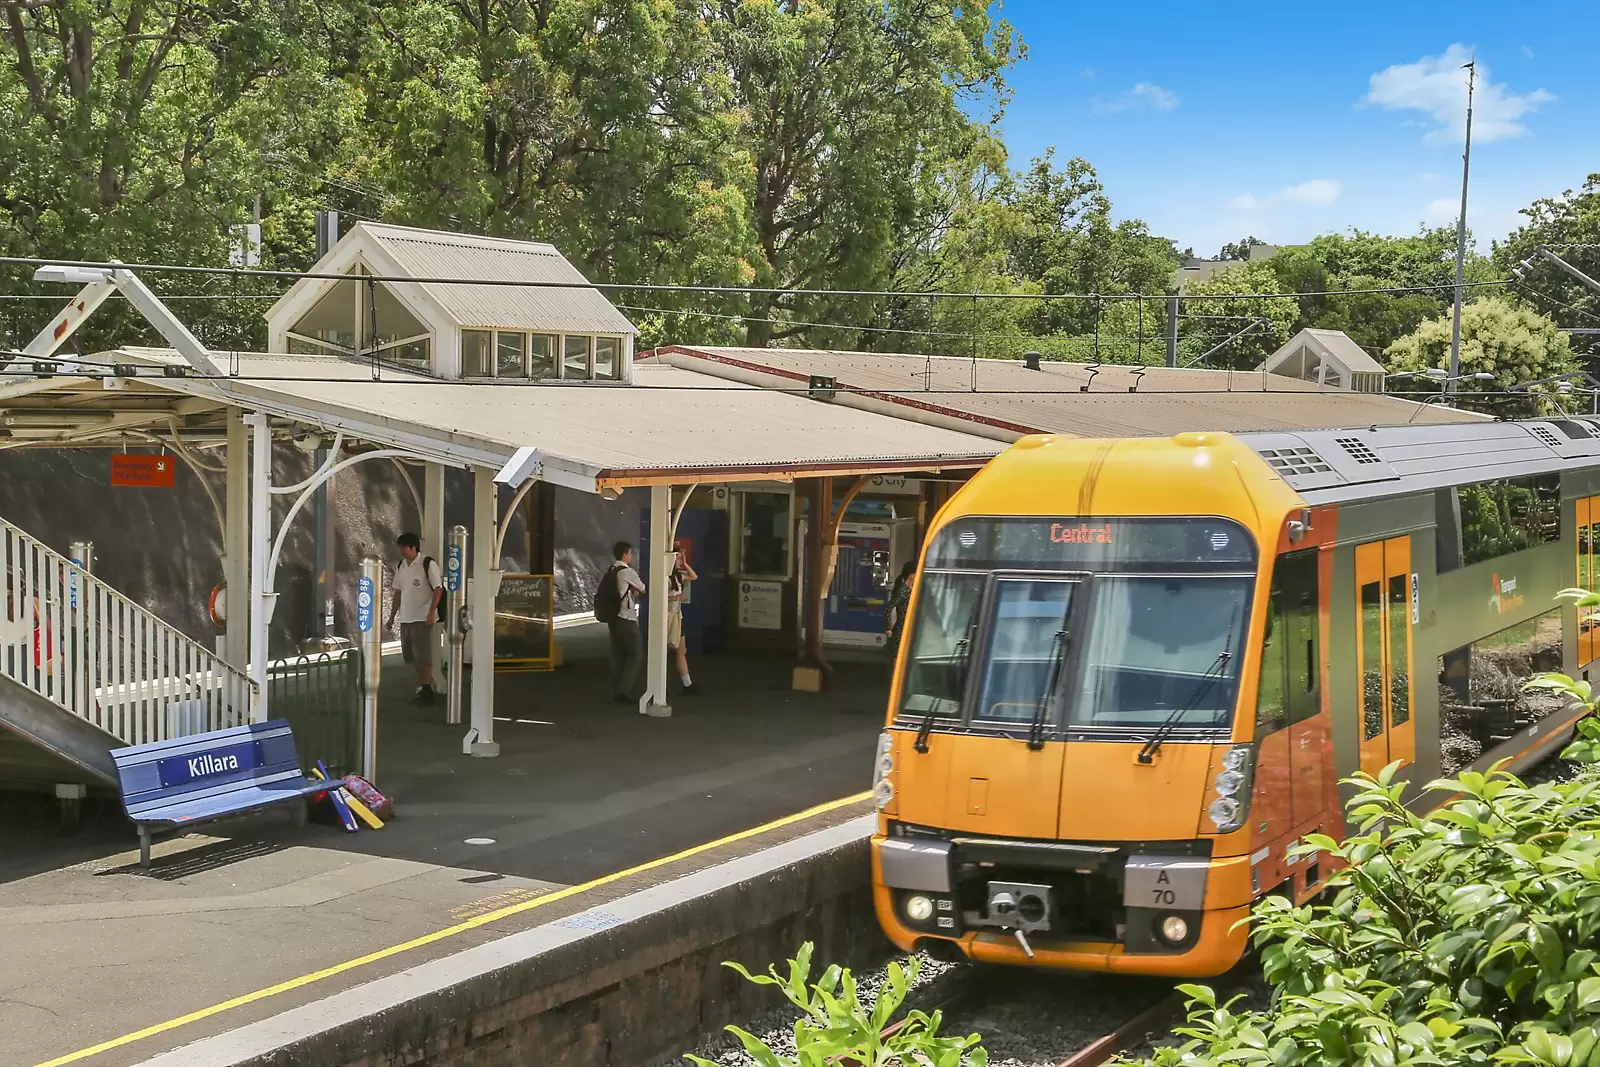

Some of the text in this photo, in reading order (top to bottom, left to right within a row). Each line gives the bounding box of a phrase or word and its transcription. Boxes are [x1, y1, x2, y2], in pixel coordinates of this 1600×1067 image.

[1050, 523, 1112, 544] Central
[188, 754, 239, 777] Killara
[1156, 869, 1170, 885] A
[1152, 889, 1175, 905] 70
